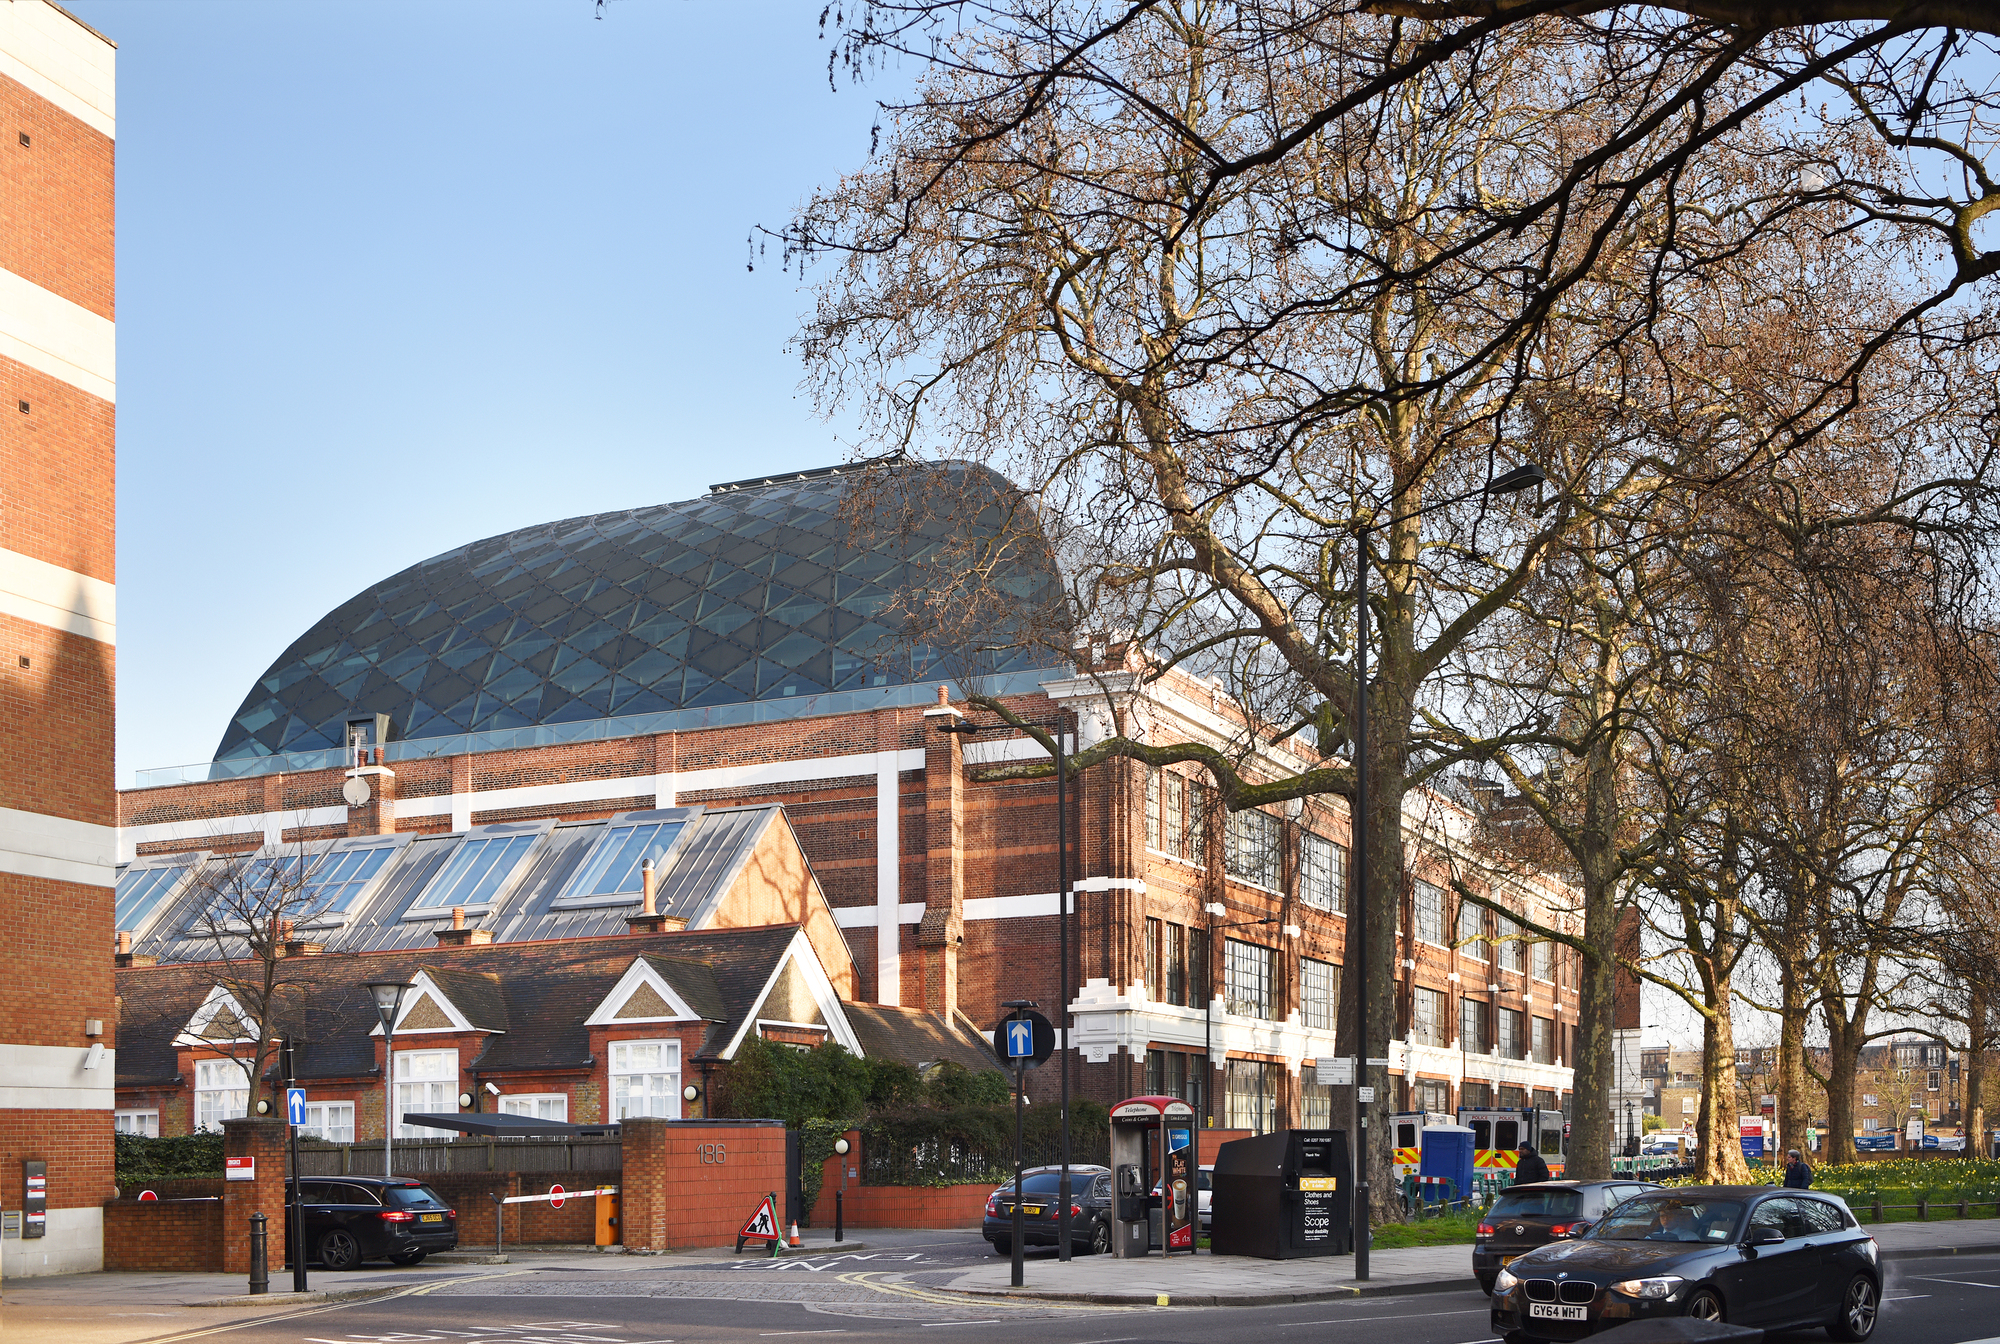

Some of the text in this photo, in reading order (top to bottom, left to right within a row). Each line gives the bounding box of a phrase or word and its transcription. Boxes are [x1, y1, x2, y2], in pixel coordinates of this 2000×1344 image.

[696, 1143, 726, 1164] 186
[1304, 1215, 1330, 1229] Scope
[1534, 1305, 1582, 1318] GY64 WHT
